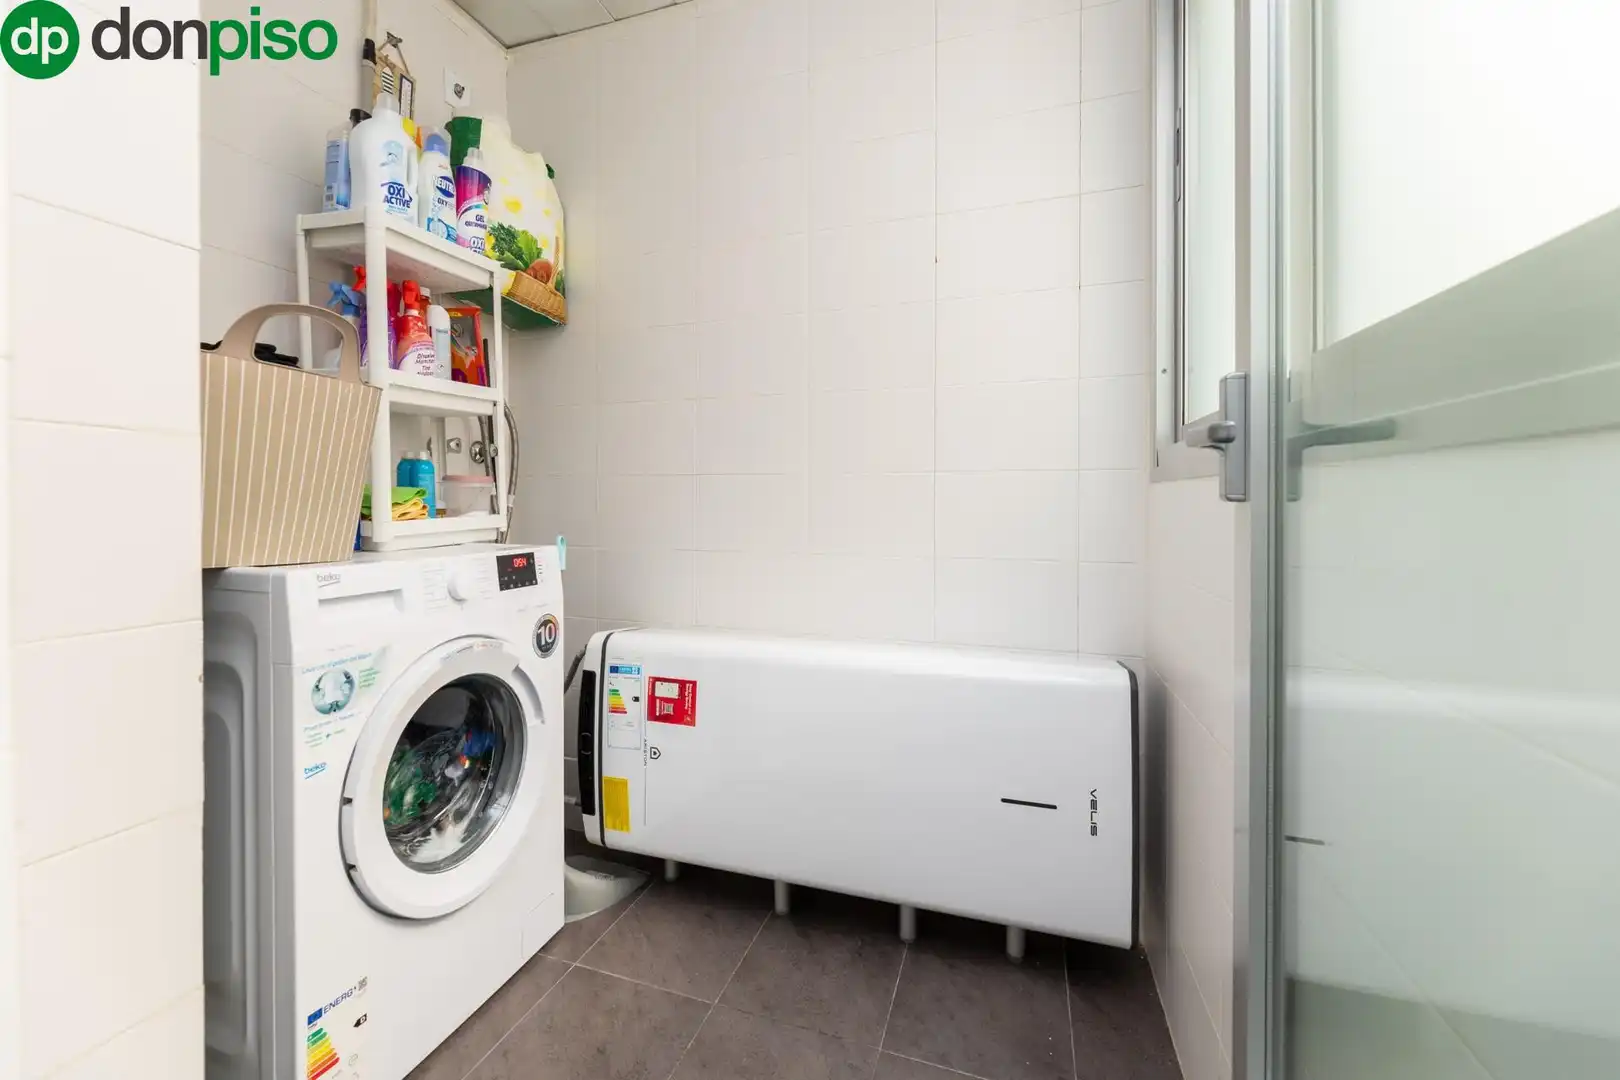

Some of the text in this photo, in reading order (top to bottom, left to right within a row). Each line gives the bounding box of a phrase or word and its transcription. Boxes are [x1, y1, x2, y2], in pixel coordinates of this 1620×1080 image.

[387, 184, 406, 199] OXI
[383, 195, 411, 209] ACTIVE
[537, 622, 556, 646] 10
[304, 762, 327, 776] beko
[1090, 788, 1098, 836] VELIS
